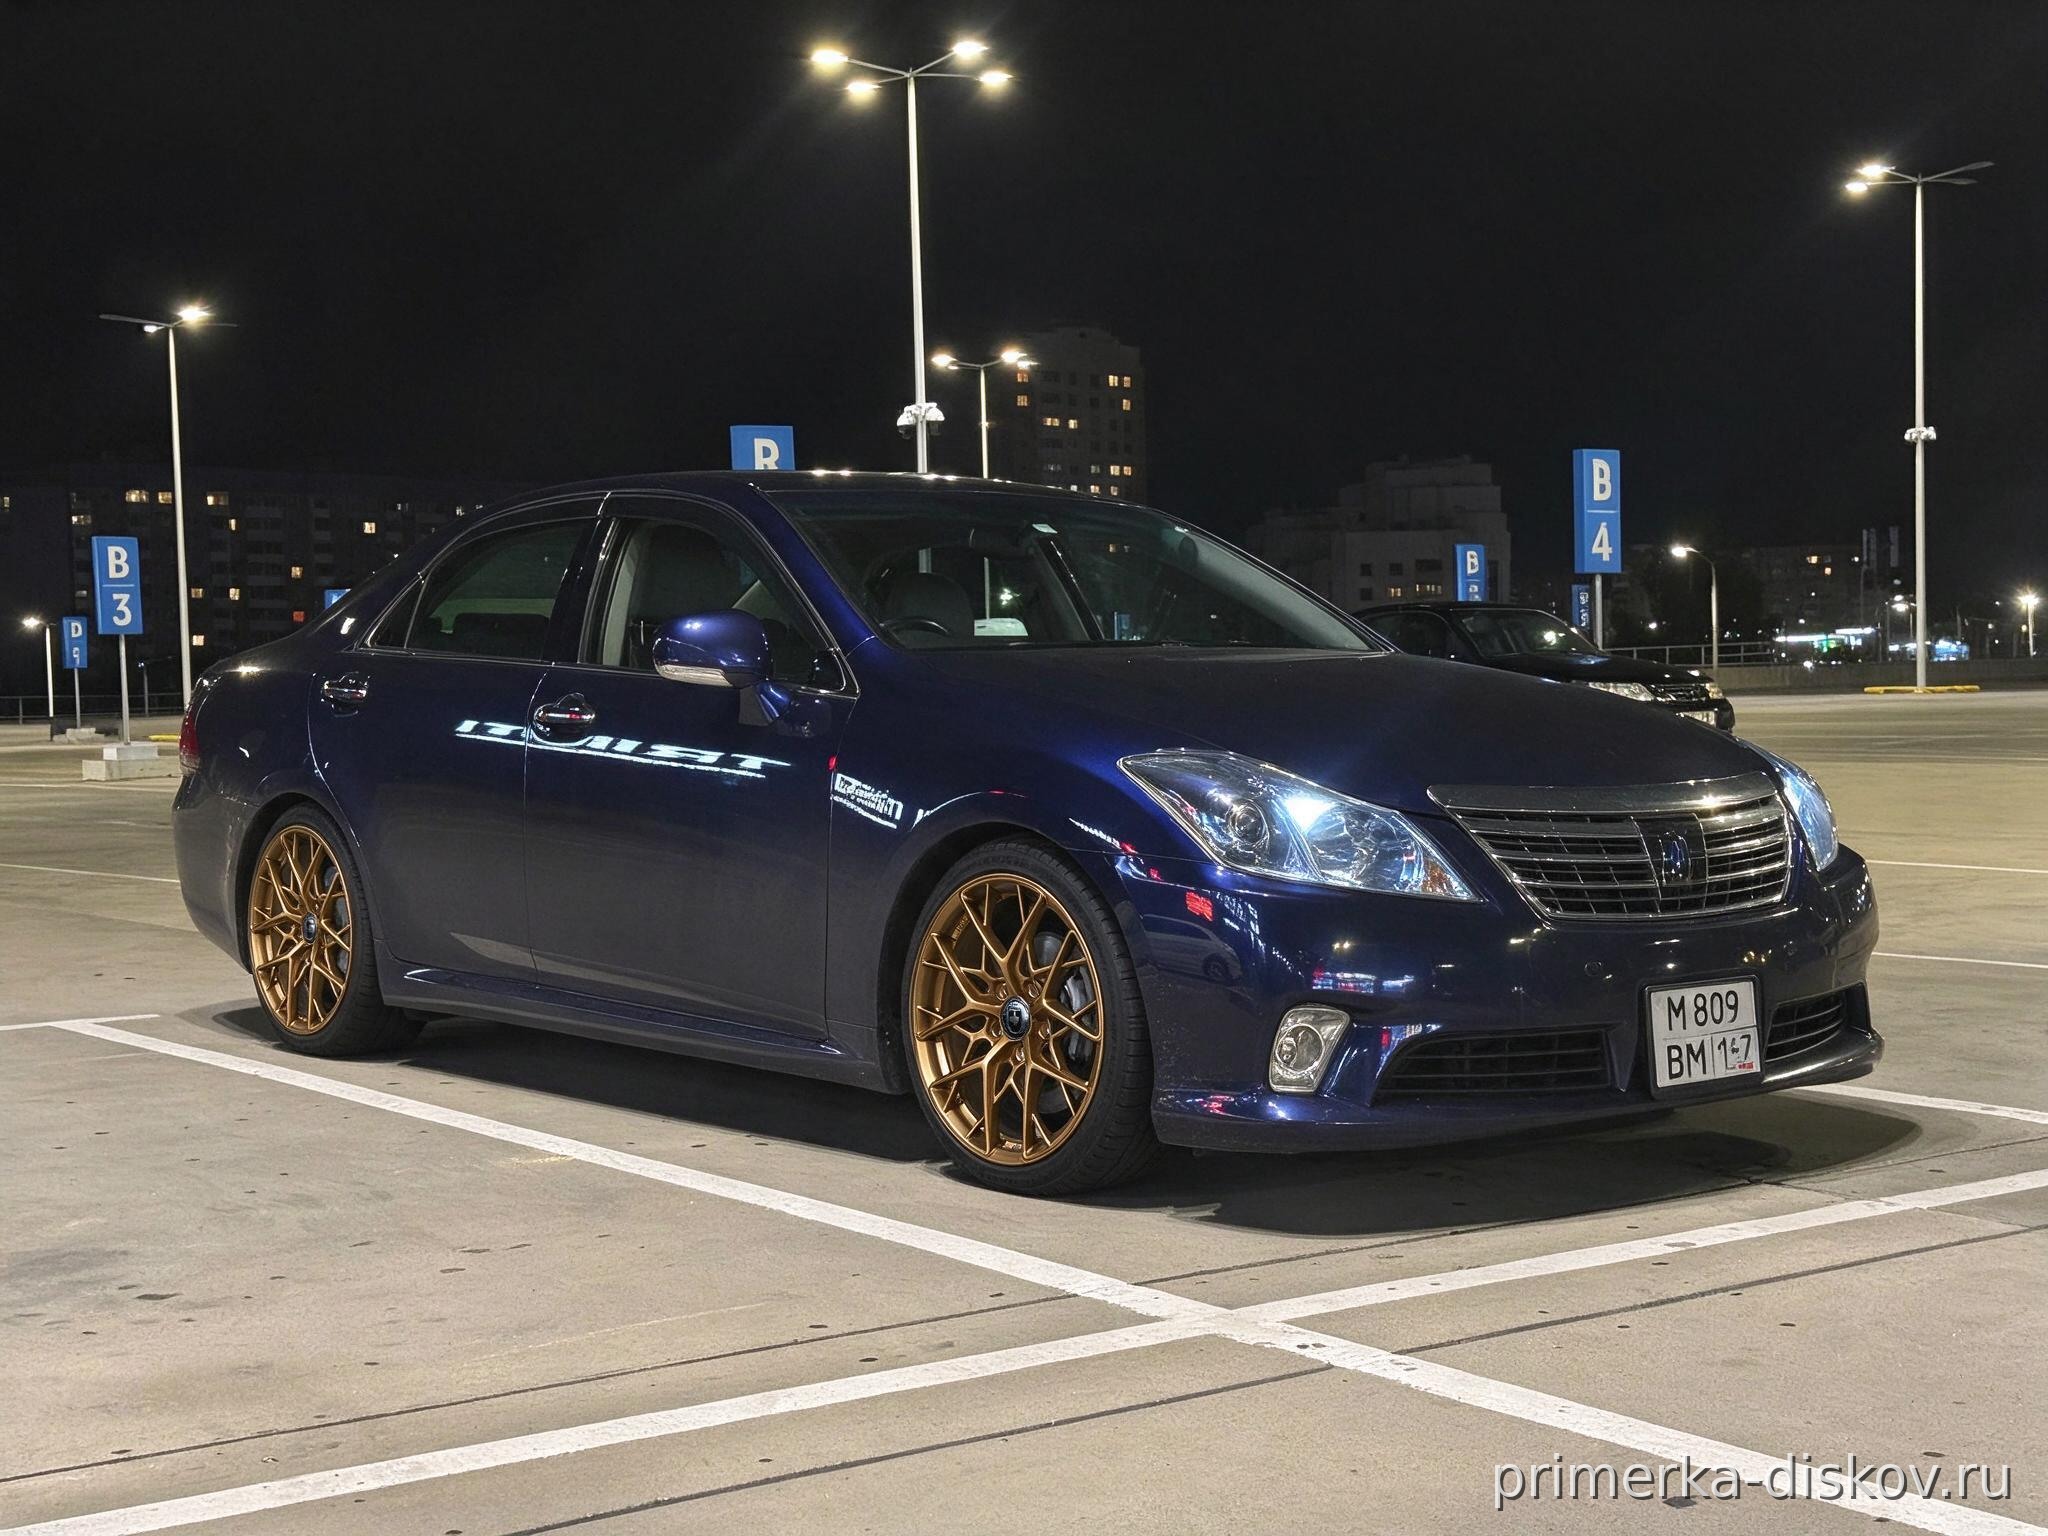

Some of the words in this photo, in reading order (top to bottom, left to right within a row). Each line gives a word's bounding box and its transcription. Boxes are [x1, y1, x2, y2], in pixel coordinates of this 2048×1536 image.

[1592, 459, 1612, 501] B
[1592, 522, 1613, 562] 4
[107, 546, 130, 579] B
[112, 593, 133, 627] 3
[1667, 995, 1687, 1031] M
[1694, 990, 1739, 1027] 809
[1667, 1039, 1707, 1080] BM
